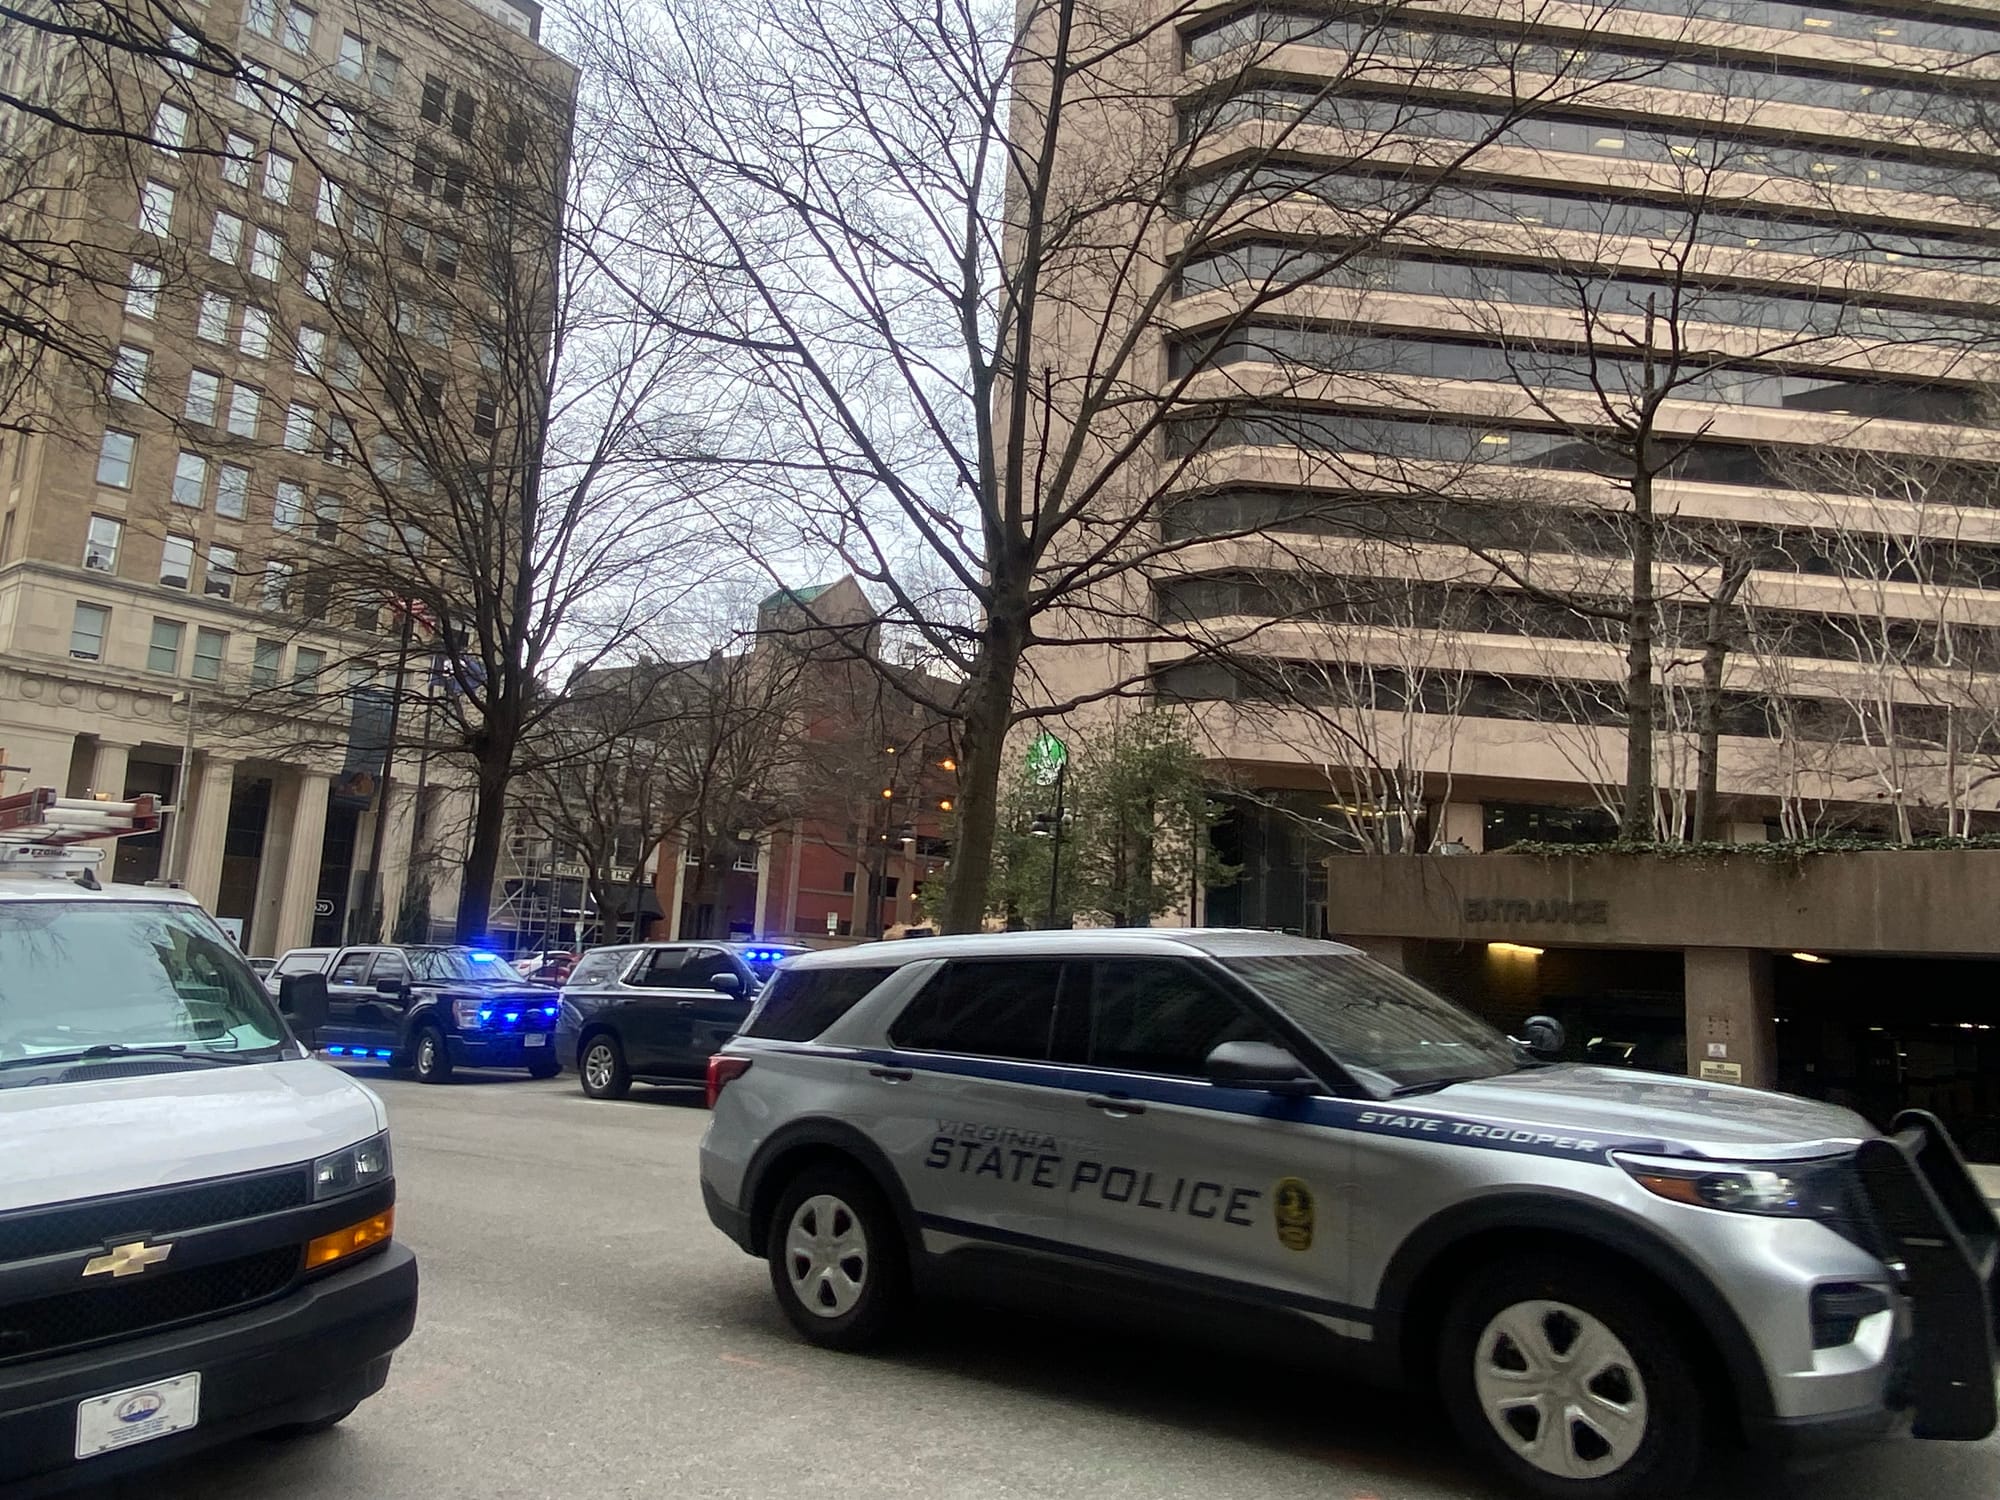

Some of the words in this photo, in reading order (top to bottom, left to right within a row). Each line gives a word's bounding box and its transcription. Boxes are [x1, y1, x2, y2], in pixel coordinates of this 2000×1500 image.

[615, 869, 653, 884] HOE
[1463, 898, 1608, 924] ENTRANCE
[936, 1119, 1058, 1151] VIRGINIA
[1357, 1112, 1444, 1131] STATE
[1450, 1122, 1600, 1152] TROOPER
[925, 1137, 1062, 1188] STATE
[1070, 1161, 1263, 1227] POLICE
